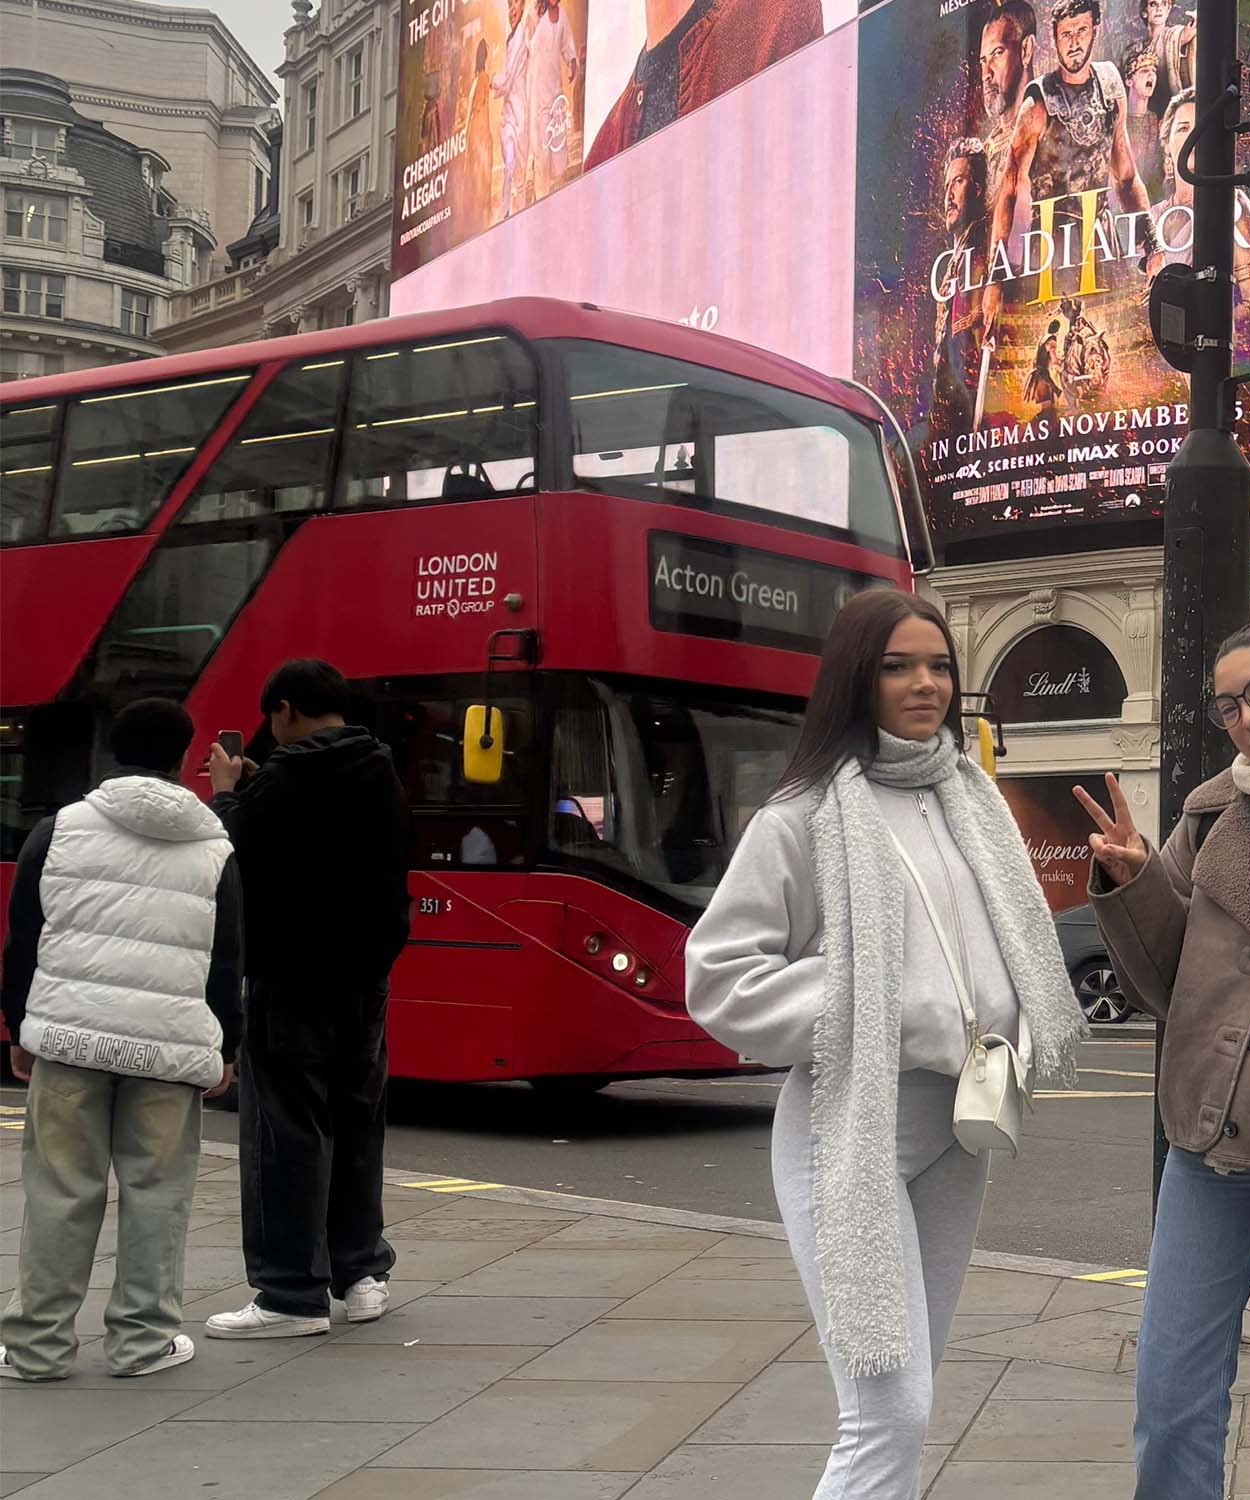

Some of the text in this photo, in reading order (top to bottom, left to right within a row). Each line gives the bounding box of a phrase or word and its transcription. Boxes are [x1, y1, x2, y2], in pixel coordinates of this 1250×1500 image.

[409, 9, 430, 46] THE
[403, 129, 467, 190] CHERISHING
[402, 170, 448, 220] A LEGACY
[932, 441, 949, 461] IN
[956, 419, 1049, 453] CINEMAS
[1059, 403, 1189, 436] NOVEMBE
[988, 453, 1045, 473] SCREENX
[1047, 455, 1065, 463] AND
[1067, 443, 1120, 463] IMAX
[1128, 437, 1183, 457] BOOK
[418, 552, 497, 576] LONDON
[417, 577, 496, 599] UNITED
[655, 554, 722, 599] Acton
[731, 572, 797, 613] Green
[416, 601, 494, 616] RATP GROUP
[1023, 671, 1078, 697] Lindt
[1025, 838, 1089, 867] ulgence
[1041, 866, 1075, 884] making
[420, 897, 439, 915] 351
